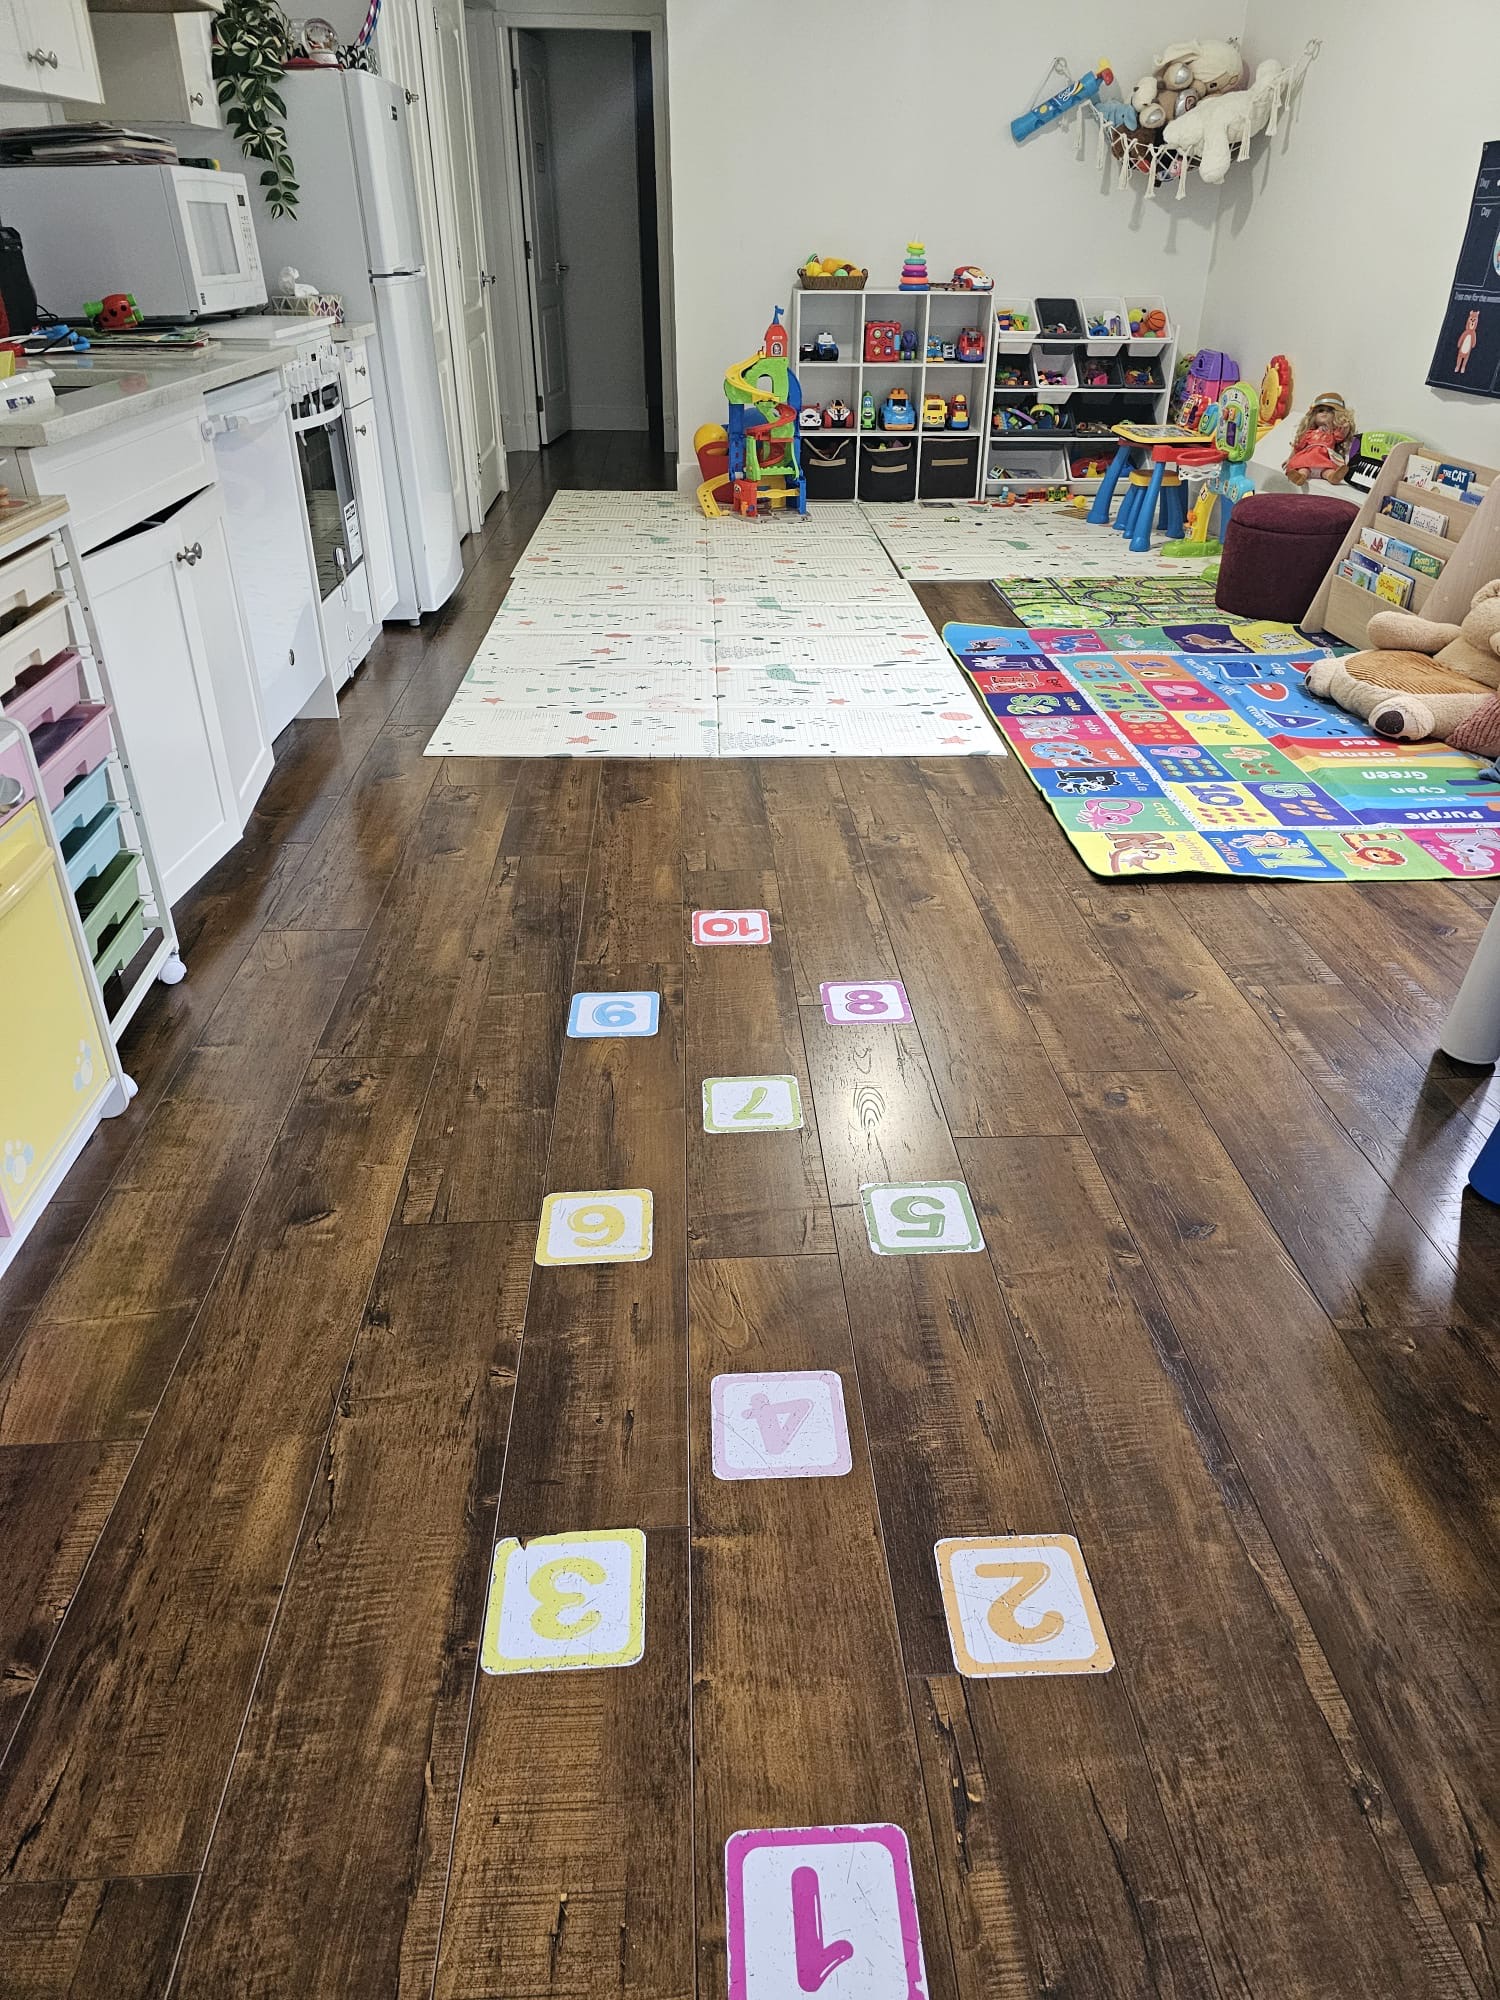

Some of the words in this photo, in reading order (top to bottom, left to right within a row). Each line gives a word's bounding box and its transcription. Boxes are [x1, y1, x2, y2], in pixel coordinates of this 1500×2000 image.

[1451, 470, 1468, 483] CAT
[1094, 682, 1137, 694] 7
[1152, 684, 1198, 697] 2
[1120, 711, 1168, 723] 8
[1184, 712, 1231, 723] 3
[1150, 746, 1201, 758] 9
[1361, 771, 1428, 780] Green
[1185, 784, 1244, 806] 10
[1258, 781, 1316, 799] 5
[1390, 787, 1446, 795] Cyan
[1404, 810, 1484, 821] Purple
[702, 917, 760, 937] 10
[845, 989, 889, 1015] 8
[732, 1086, 774, 1121] 7
[889, 1195, 946, 1238] 5
[741, 1393, 815, 1455] 4
[527, 1555, 608, 1641] 3
[973, 1561, 1065, 1645] 2
[790, 1865, 854, 1993] 1
